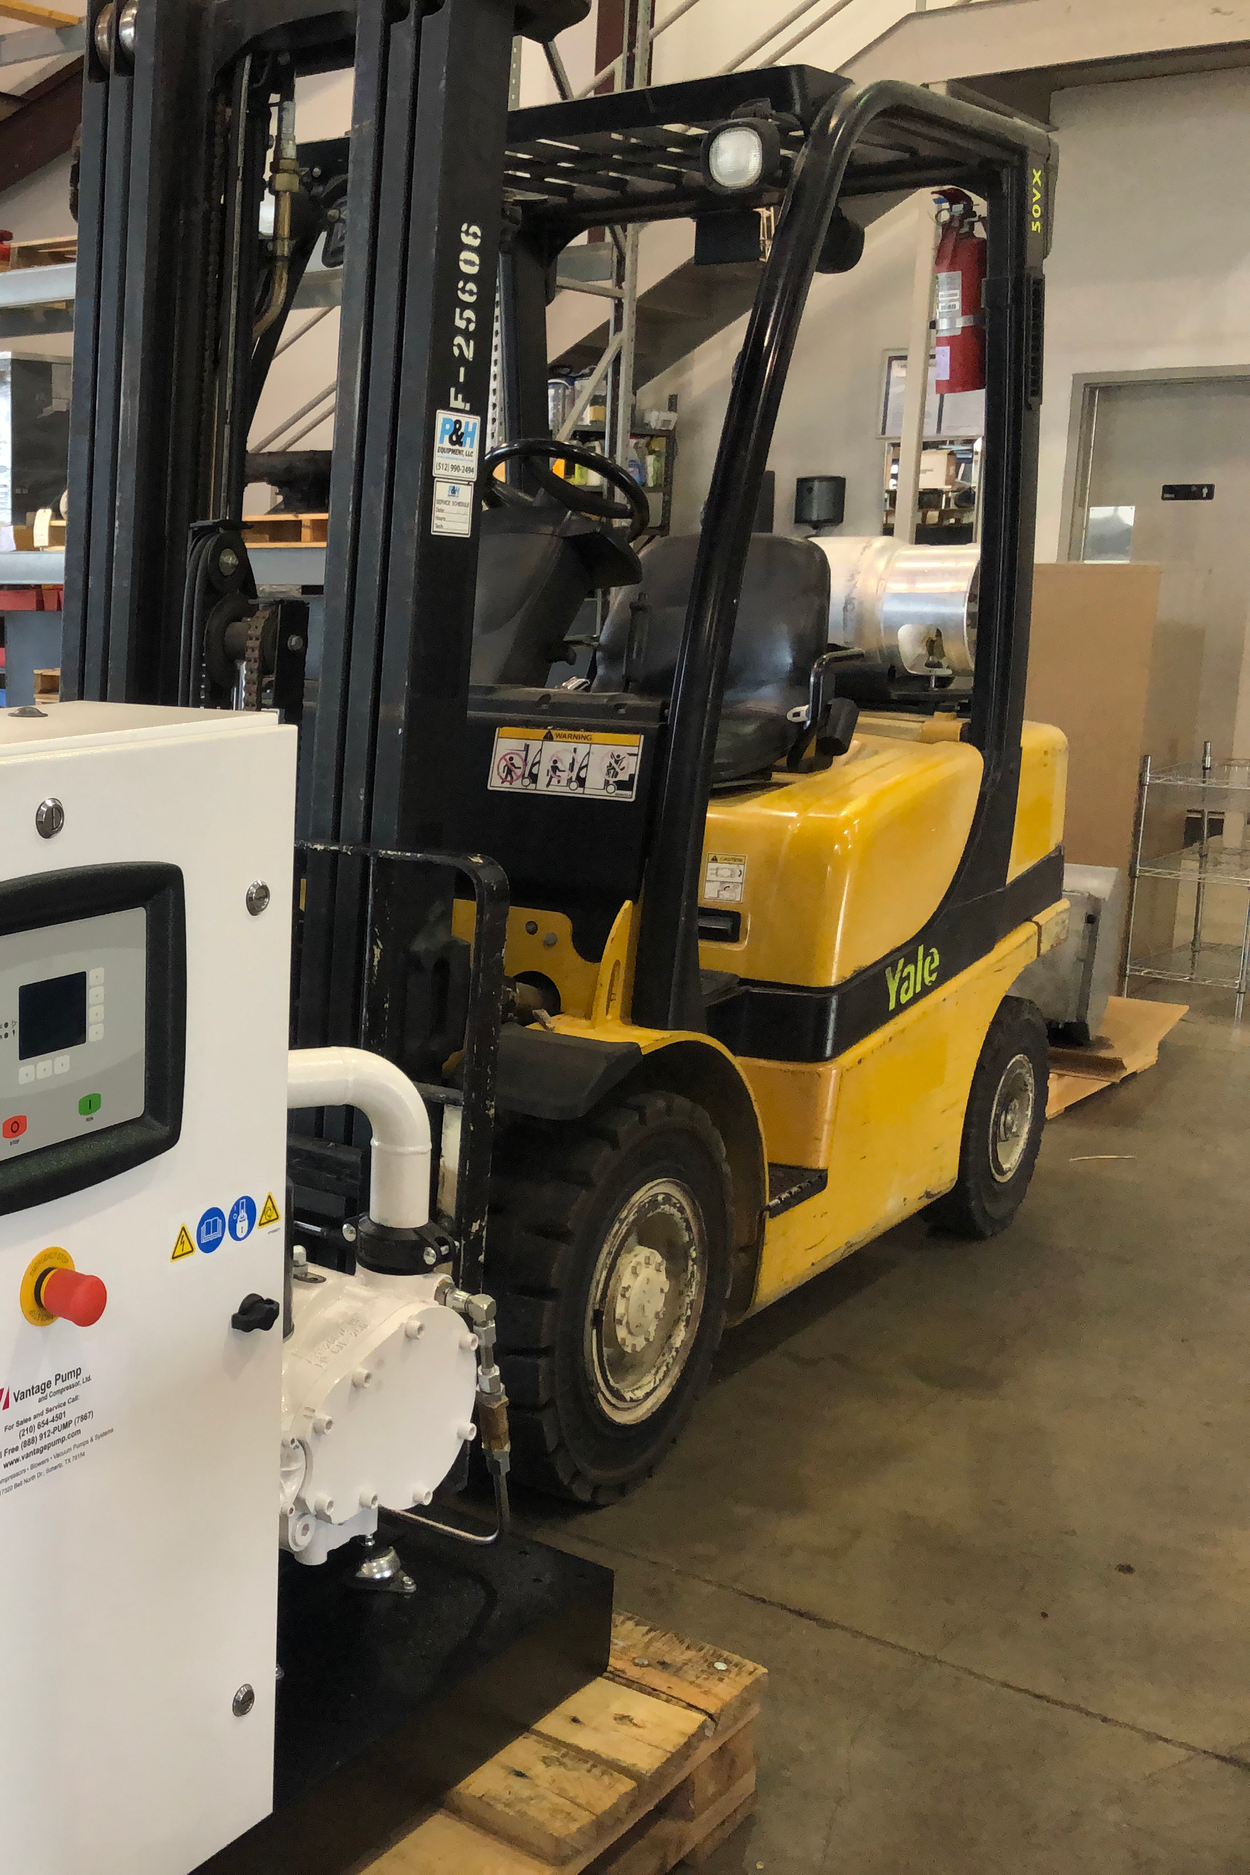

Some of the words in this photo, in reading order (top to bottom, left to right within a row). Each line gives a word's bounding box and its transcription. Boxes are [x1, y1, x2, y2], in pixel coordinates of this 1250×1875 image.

[1031, 167, 1042, 233] 50VX
[449, 222, 482, 411] F-25606
[439, 417, 477, 449] P&H
[436, 462, 449, 472] (512)
[450, 464, 474, 475] 990-2494
[554, 732, 592, 741] WARNING
[885, 944, 940, 1011] Yale
[13, 1379, 52, 1403] Vantage
[54, 1367, 82, 1385] Pump
[38, 1395, 48, 1403] and
[4, 1424, 14, 1432] For
[16, 1416, 32, 1427] Sales
[33, 1412, 44, 1420] and
[45, 1402, 66, 1413] Service
[67, 1395, 80, 1404] Call:
[18, 1424, 36, 1439] (210)
[37, 1411, 66, 1429] 654-4501
[3, 1444, 20, 1458] Free
[20, 1436, 37, 1452] (888)
[39, 1420, 73, 1442] 912-PUMP
[74, 1410, 94, 1428] (7867)
[3, 1428, 82, 1470] www.vantagepump.com
